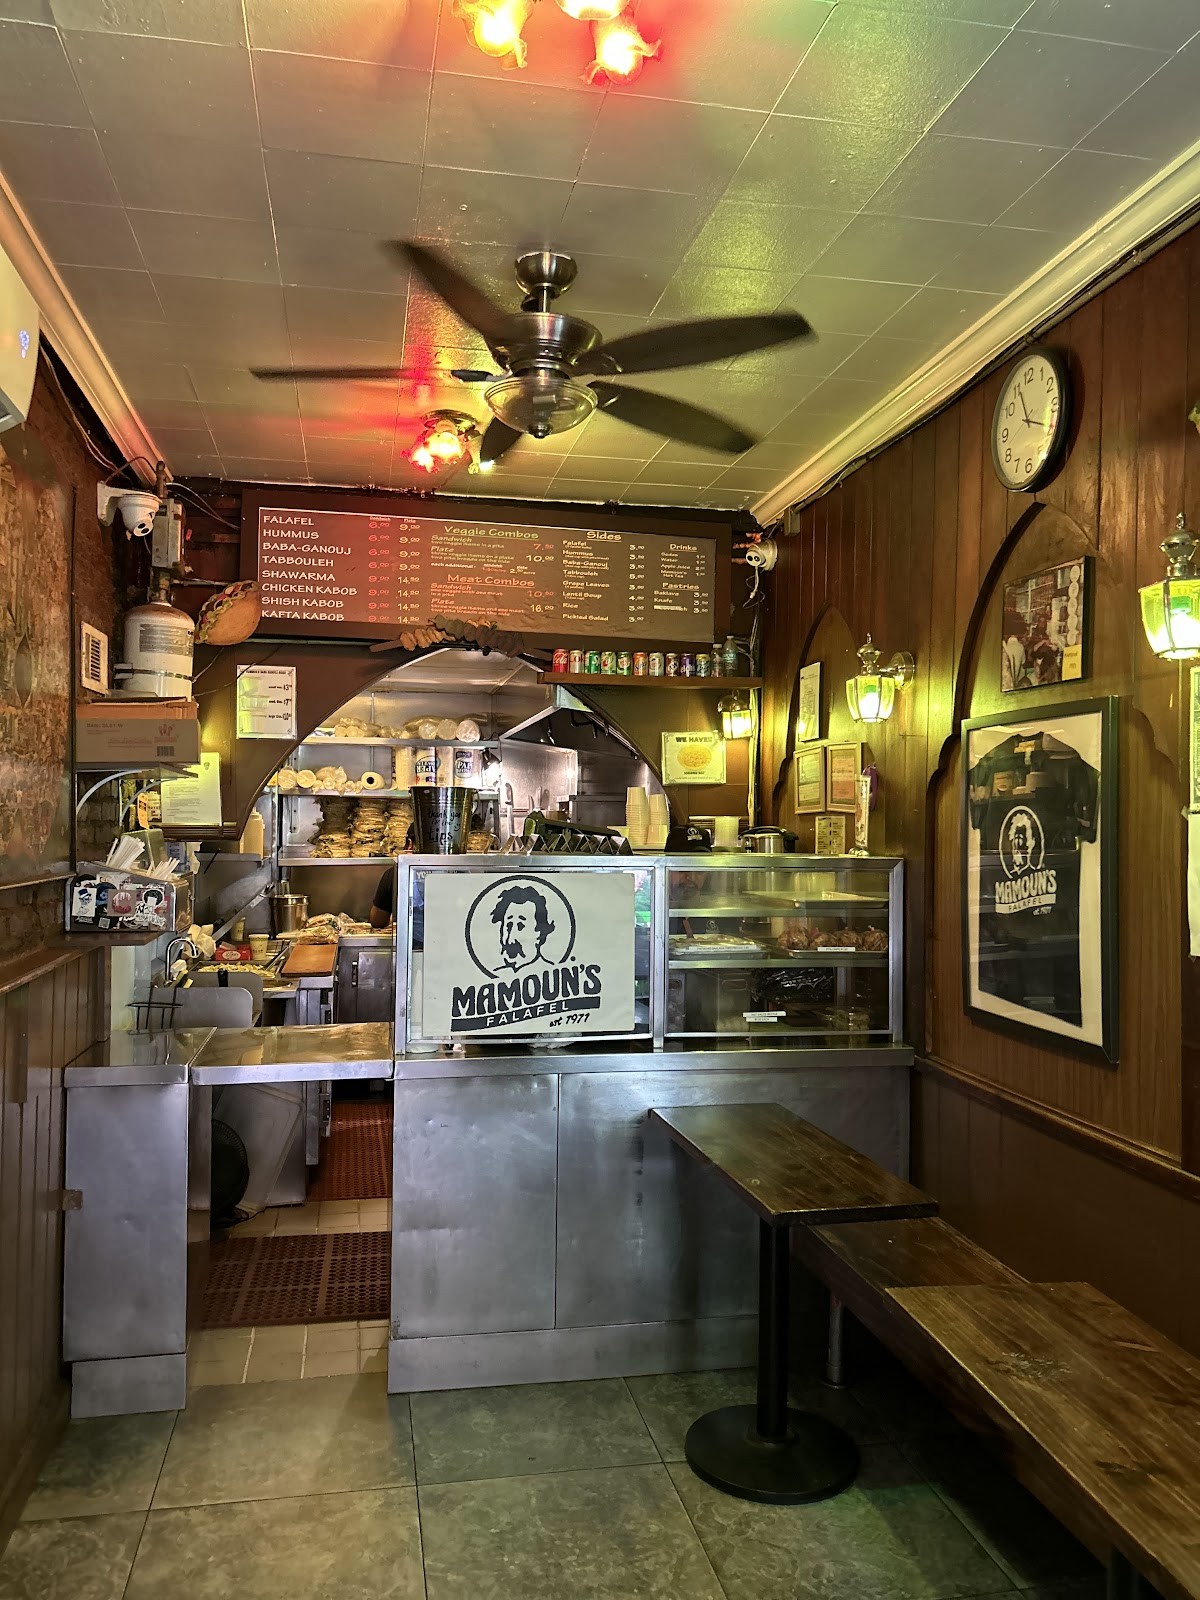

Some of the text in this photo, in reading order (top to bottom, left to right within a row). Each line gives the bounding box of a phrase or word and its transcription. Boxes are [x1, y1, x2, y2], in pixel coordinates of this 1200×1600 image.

[1023, 367, 1034, 386] 12
[1039, 366, 1044, 381] 1
[1013, 382, 1022, 399] 11
[1046, 376, 1054, 394] 2
[1005, 402, 1015, 419] 10
[1051, 397, 1058, 413] 3
[1001, 428, 1009, 443] 9
[1004, 448, 1012, 463] 8
[1014, 457, 1020, 473] 7
[1024, 457, 1032, 474] 6
[263, 515, 314, 527] FALAFEL
[399, 523, 421, 531] 9.00
[263, 528, 320, 540] HUMMUS
[399, 536, 421, 544] 9.00
[431, 534, 472, 543] Sandwich
[444, 525, 539, 539] Veggie Combos
[586, 531, 622, 541] Sides
[262, 542, 352, 556] BABA-GANOUJ
[399, 550, 421, 558] 9.00
[430, 545, 455, 553] Plate
[562, 549, 594, 557] Hummus
[669, 543, 698, 551] Drinks
[262, 556, 335, 568] TABBOULEH
[399, 563, 421, 571] 9.00
[526, 555, 554, 563] 10.00
[562, 559, 608, 570] Baba-Ganouj
[261, 569, 336, 582] SHAWARMA
[562, 569, 599, 577] Tabbouleh
[430, 582, 472, 591] Sandwich
[447, 574, 535, 587] Meat Combos
[562, 580, 585, 588] Grape
[585, 581, 610, 589] Leaves
[662, 582, 700, 590] Pastries
[261, 583, 314, 595] CHICKEN
[316, 584, 358, 596] KABOB
[583, 592, 602, 600] Soup
[261, 596, 300, 607] SHISH
[302, 597, 345, 609] KABOB
[431, 597, 455, 605] Plate
[530, 604, 554, 613] 16.00
[261, 609, 301, 620] KAFTA
[302, 611, 345, 623] KABOB
[995, 869, 1058, 903] MAMOUN'S
[1008, 897, 1042, 912] FALAFEL
[451, 963, 602, 1018] MAMOUN'S
[485, 1000, 570, 1027] FALAFEL
[549, 1012, 591, 1028] est 1971
